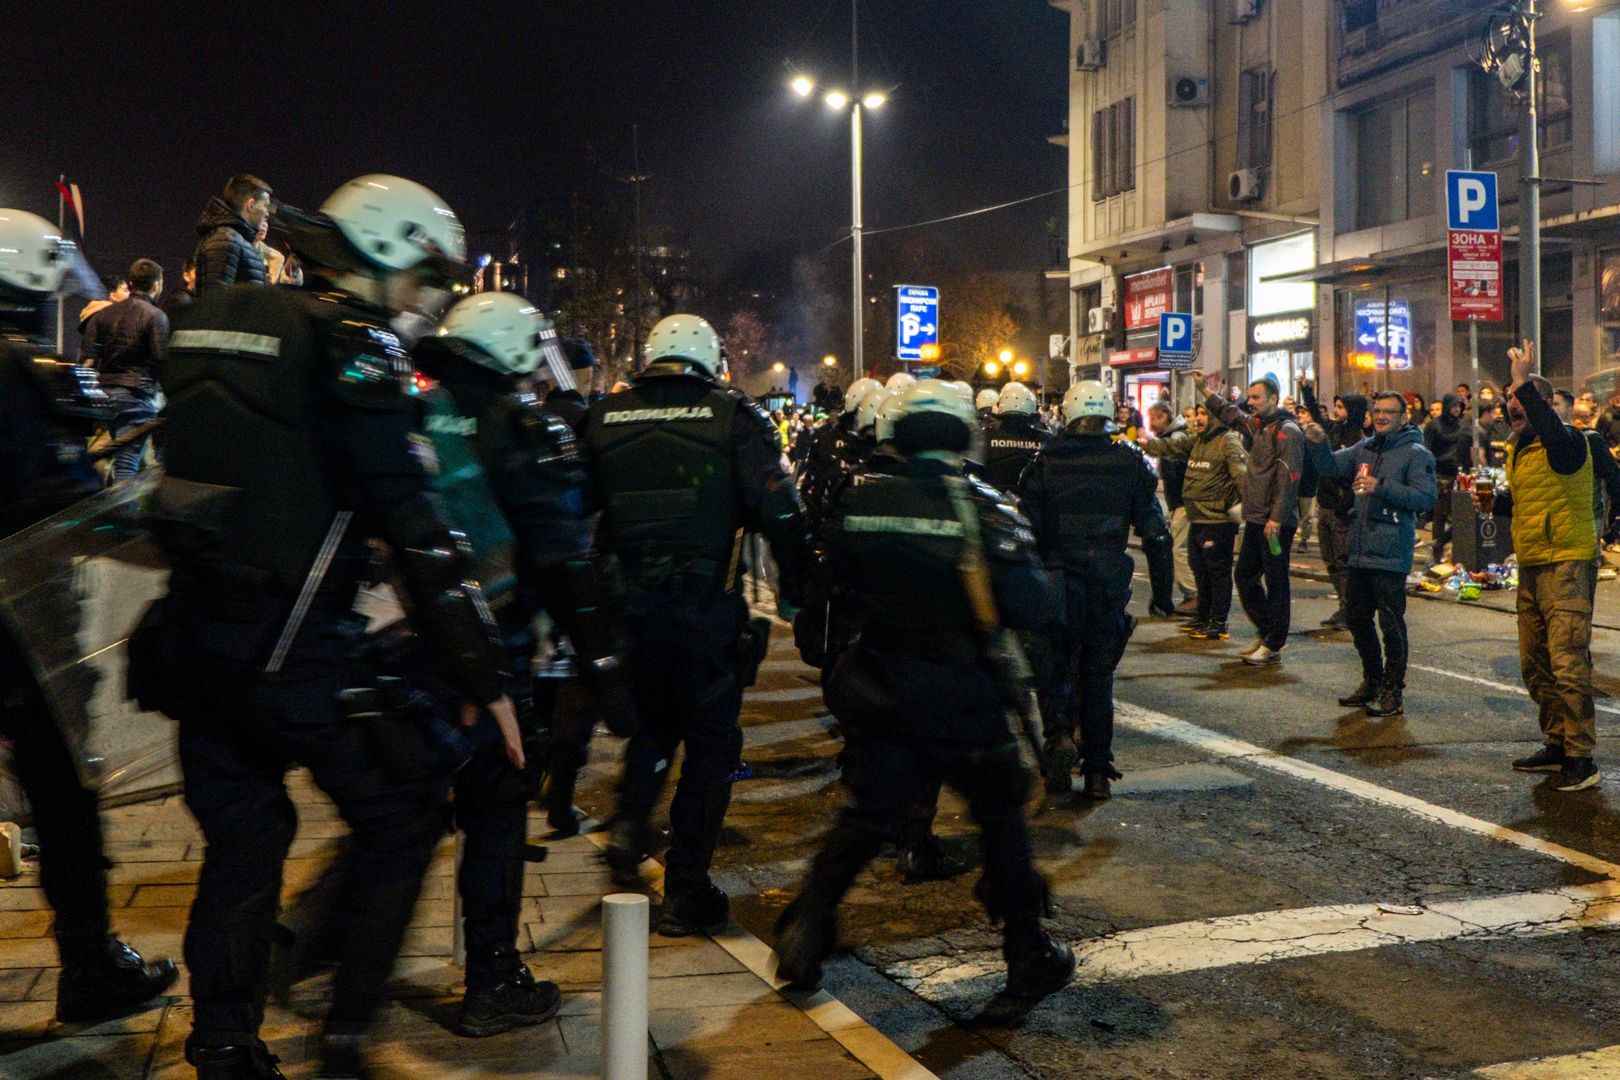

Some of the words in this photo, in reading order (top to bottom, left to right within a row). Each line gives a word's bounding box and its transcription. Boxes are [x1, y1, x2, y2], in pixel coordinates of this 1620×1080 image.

[1458, 178, 1487, 223] P
[1452, 233, 1486, 245] ЗОНА
[1493, 234, 1498, 245] 1
[1167, 317, 1186, 347] P
[991, 439, 1041, 450] ПОЛИЦИЈ
